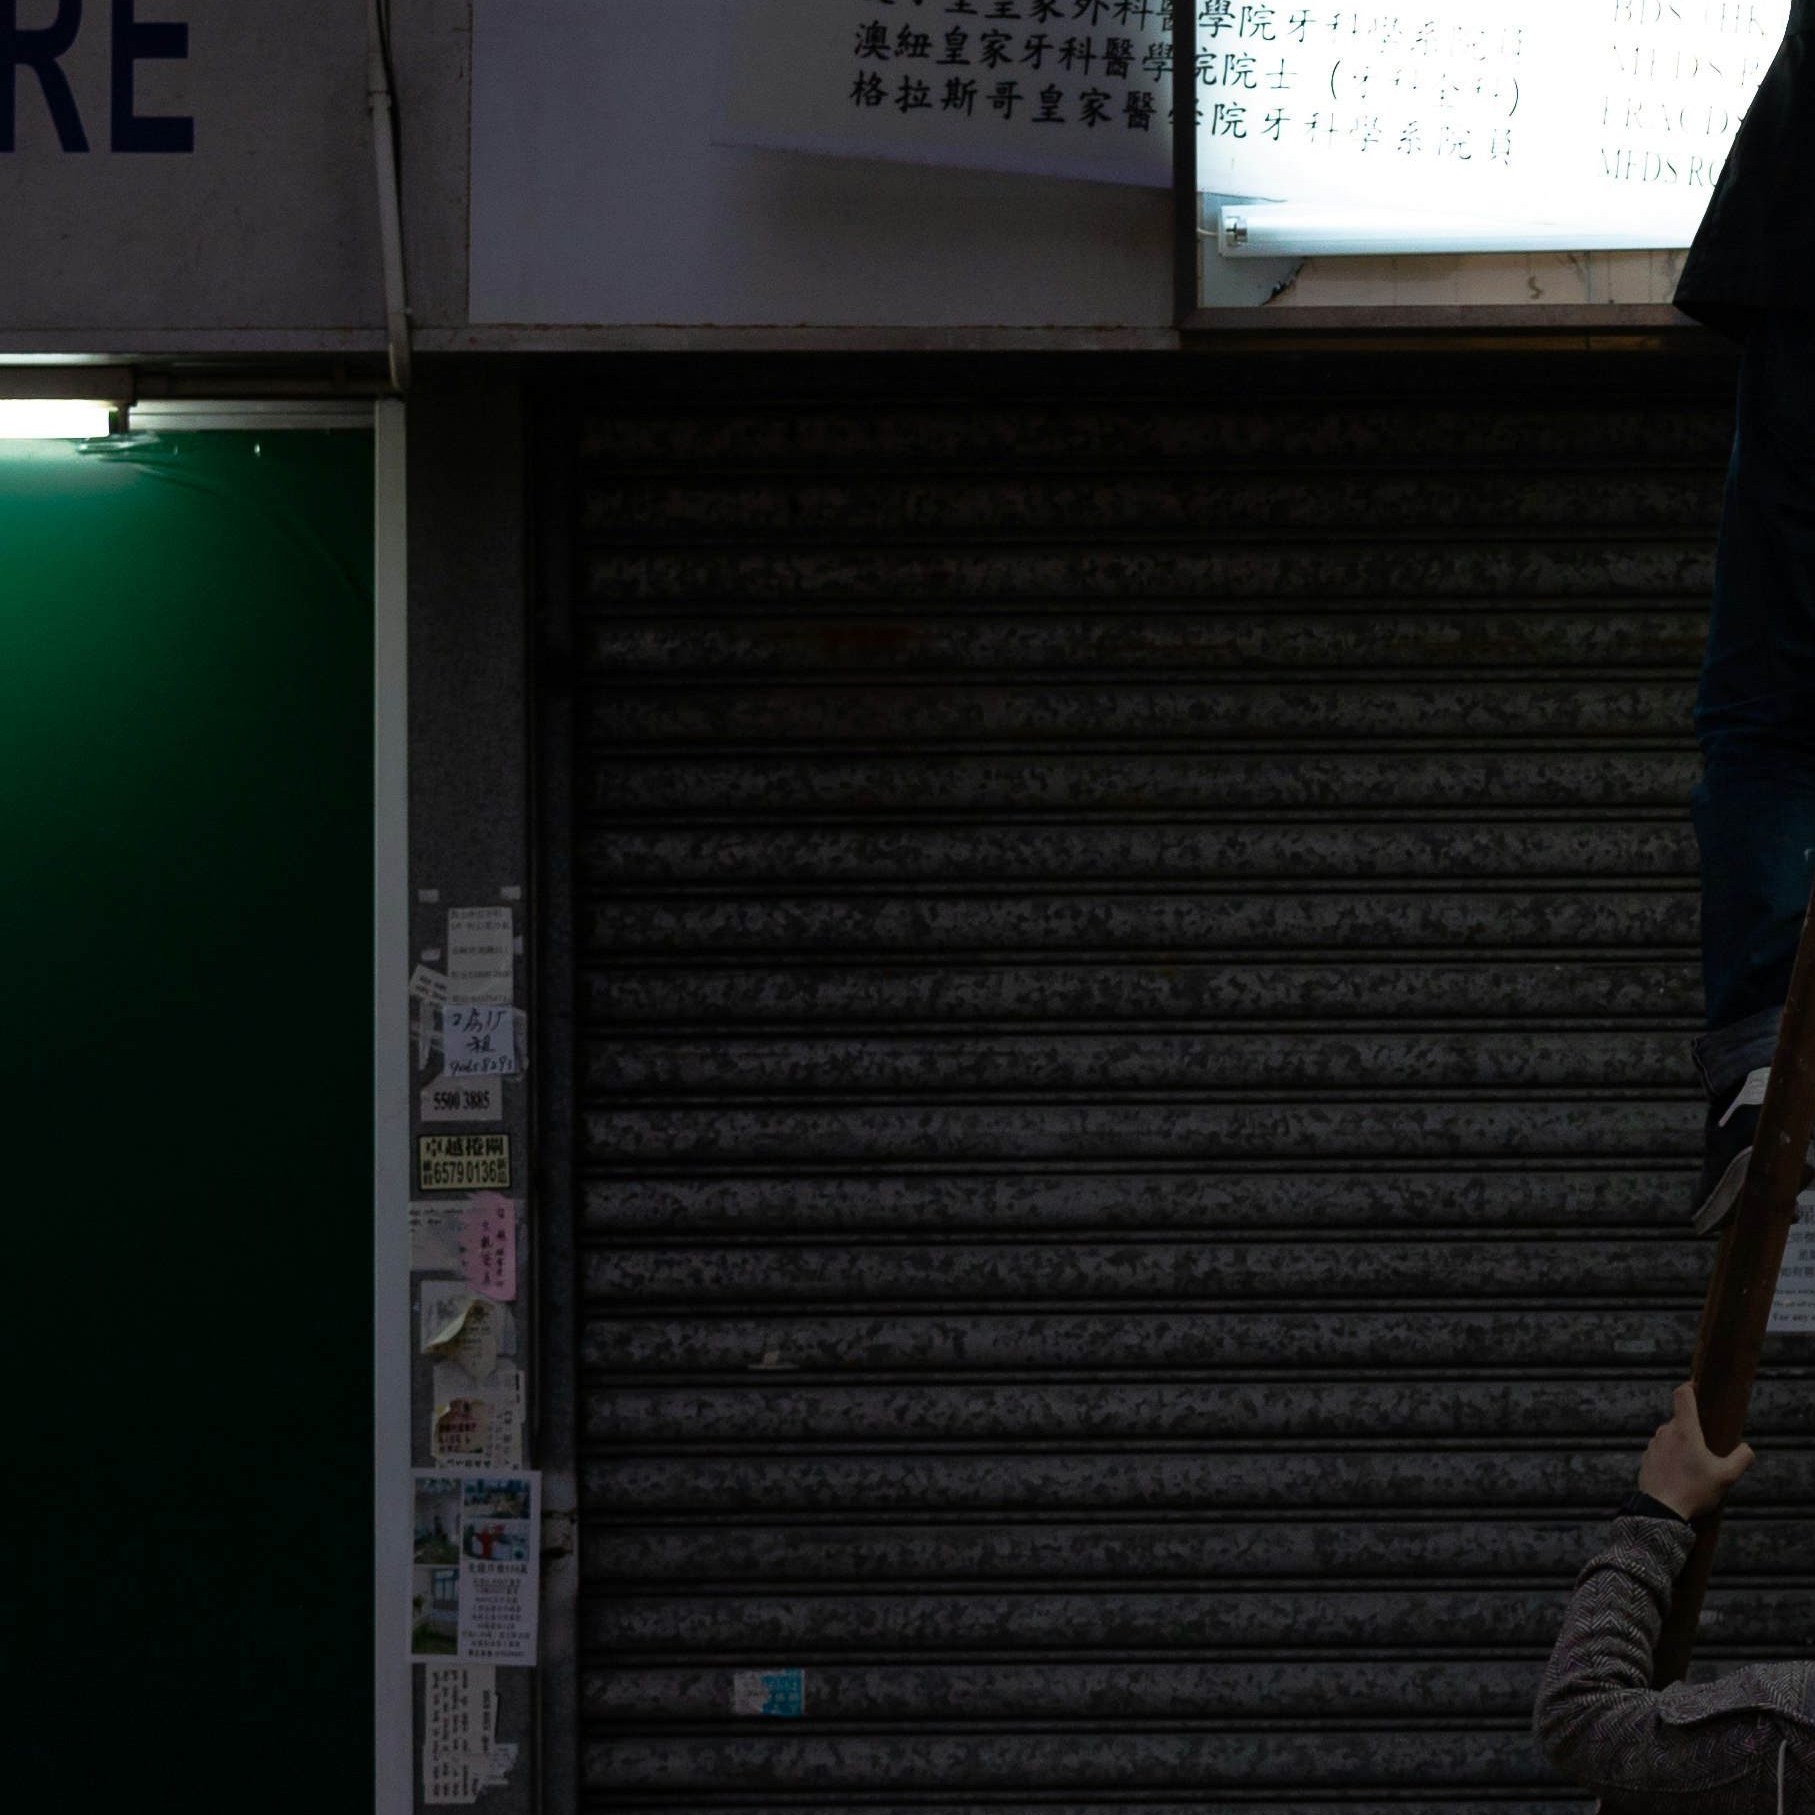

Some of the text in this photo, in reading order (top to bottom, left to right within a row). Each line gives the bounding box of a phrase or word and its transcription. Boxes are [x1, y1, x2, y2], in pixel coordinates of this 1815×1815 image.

[433, 1090, 461, 1111] 5500
[434, 1160, 465, 1184] 6579
[466, 1159, 497, 1184] 0136
